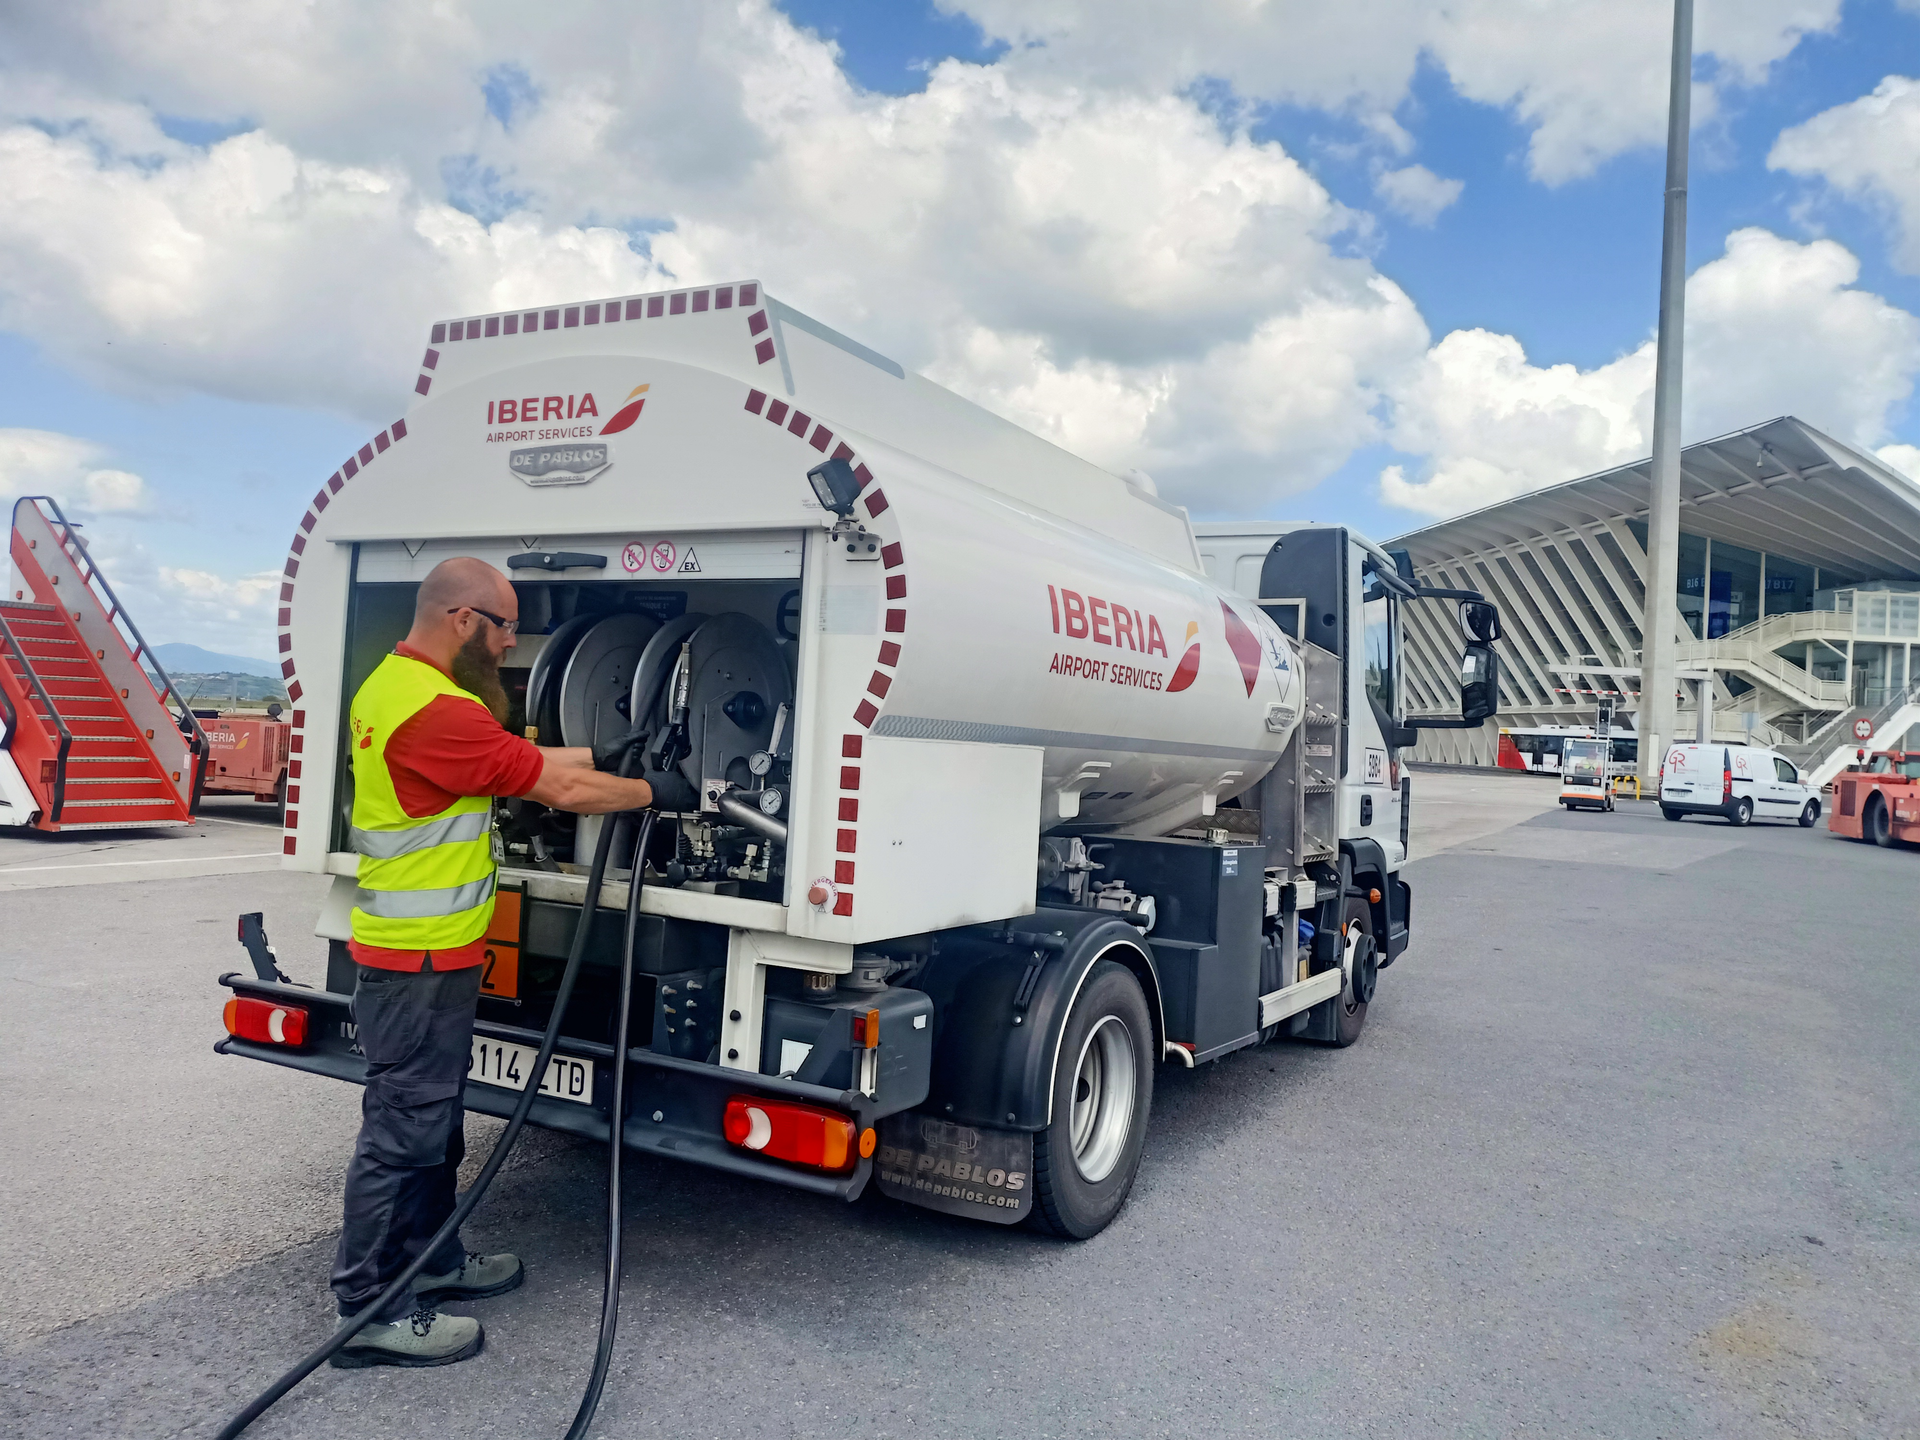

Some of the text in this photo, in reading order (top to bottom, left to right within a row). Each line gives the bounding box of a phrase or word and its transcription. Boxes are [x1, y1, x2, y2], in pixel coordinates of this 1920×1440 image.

[487, 393, 599, 425] IBERIA
[486, 426, 593, 443] AIRPORT SERVICES
[513, 448, 605, 467] DE PABLOS
[684, 561, 696, 571] EX
[1686, 577, 1699, 588] B16
[1773, 579, 1794, 589] B17
[1047, 584, 1168, 659] IBERIA
[1049, 653, 1163, 692] AIRPORT SERVICES
[206, 732, 236, 743] BERIA
[877, 1145, 1026, 1191] DE PABLOS
[881, 1170, 1020, 1209] www.depablos.com
